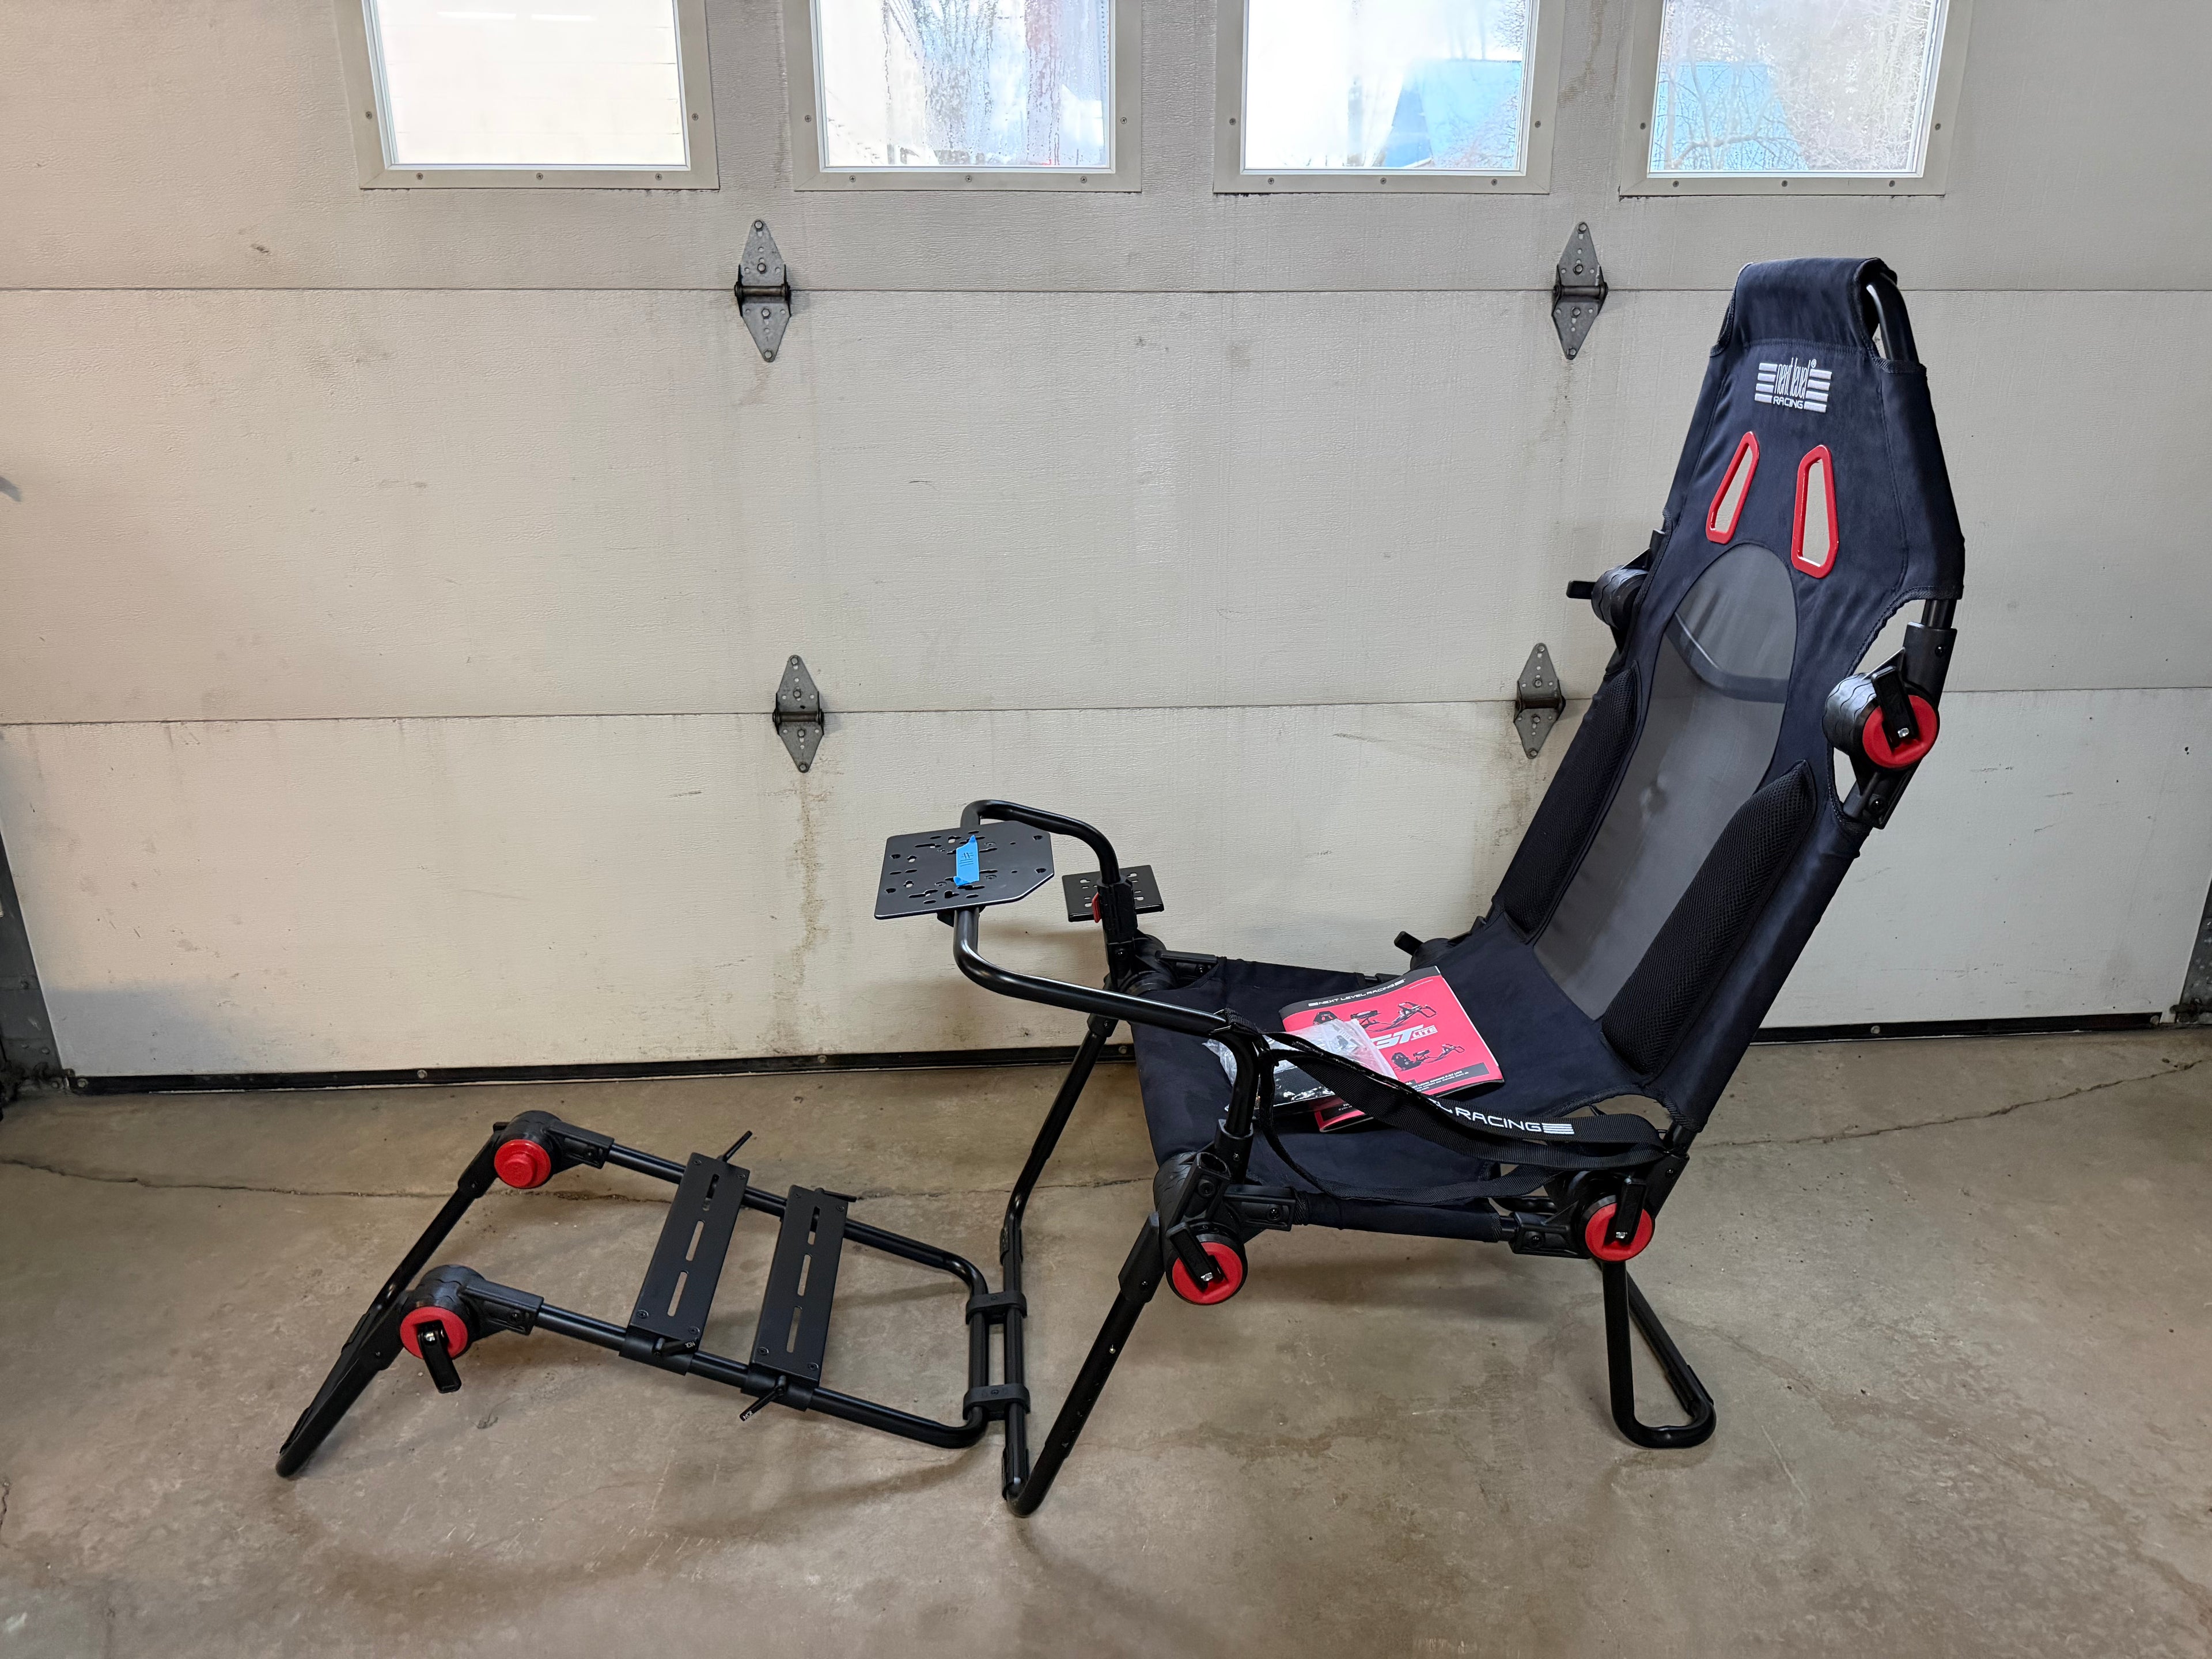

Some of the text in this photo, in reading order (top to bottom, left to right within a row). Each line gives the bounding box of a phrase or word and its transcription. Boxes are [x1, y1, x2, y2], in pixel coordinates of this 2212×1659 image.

[1773, 396, 1804, 410] RACING
[1340, 993, 1366, 1001] LEVEL
[1366, 983, 1395, 995] RACING
[1412, 1027, 1436, 1039] LITE
[1455, 1107, 1543, 1132] RACING
